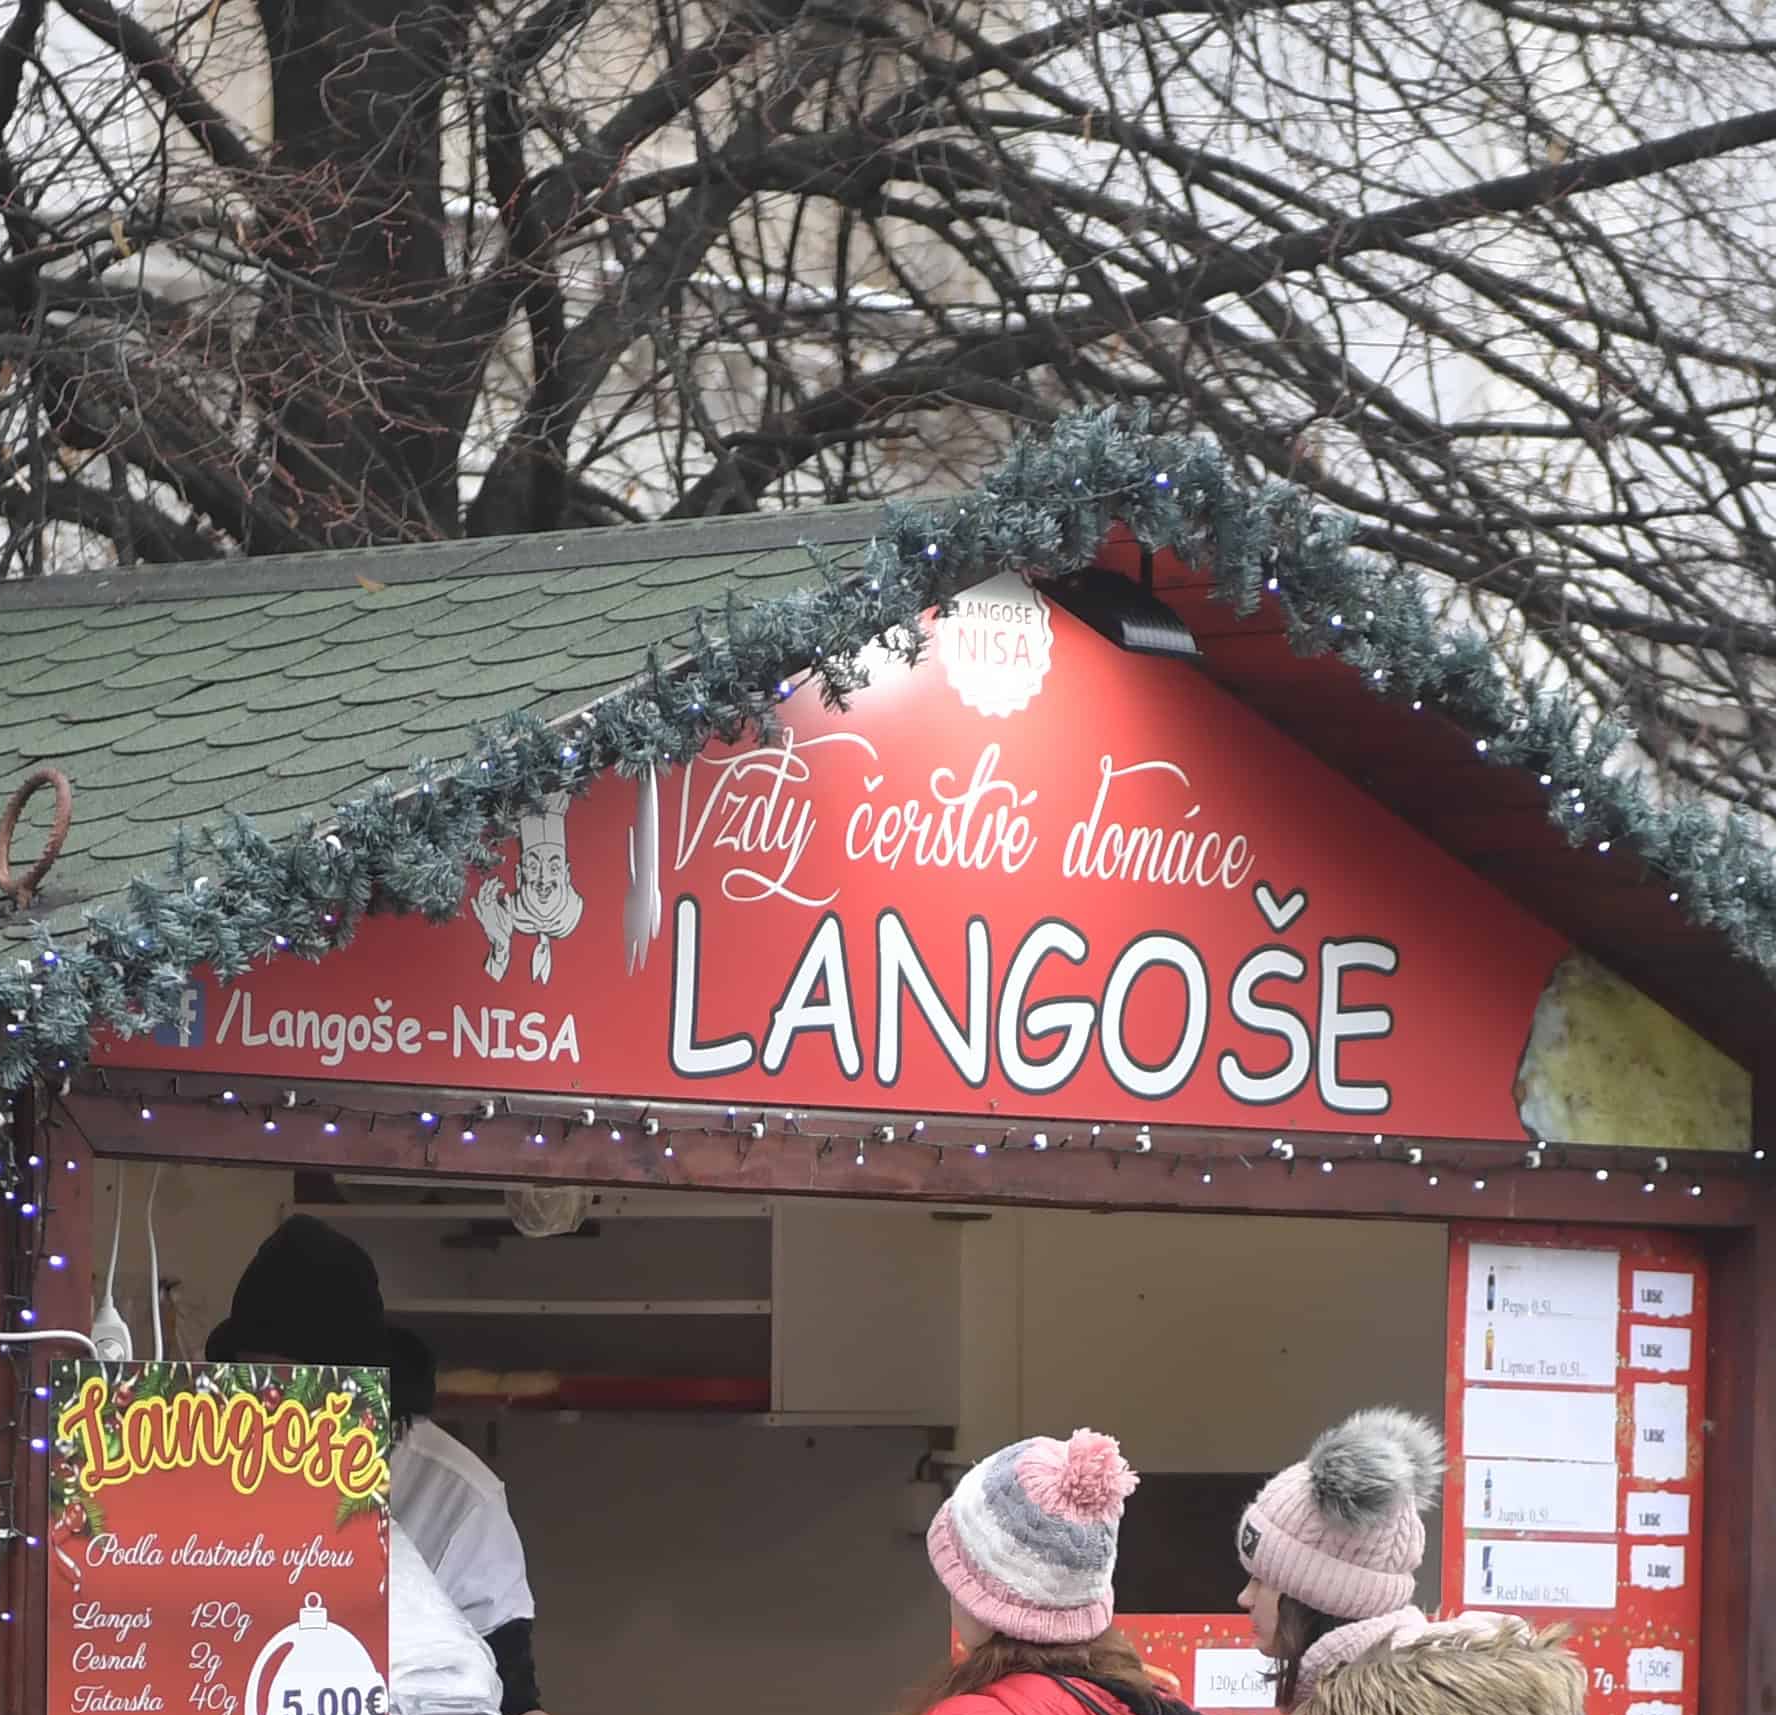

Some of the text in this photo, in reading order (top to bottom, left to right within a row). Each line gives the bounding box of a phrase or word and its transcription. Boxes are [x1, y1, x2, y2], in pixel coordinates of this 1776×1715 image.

[958, 627, 1032, 668] NISA
[844, 743, 1038, 875] čerstvé
[1062, 754, 1256, 890] domáce
[669, 881, 1399, 1115] LANGOŠE
[58, 1377, 388, 1498] Langoše
[170, 1534, 276, 1568] vlastného
[282, 1535, 354, 1584] výberu
[189, 1600, 252, 1642] 120g
[72, 1642, 223, 1683] Cesnak 2g
